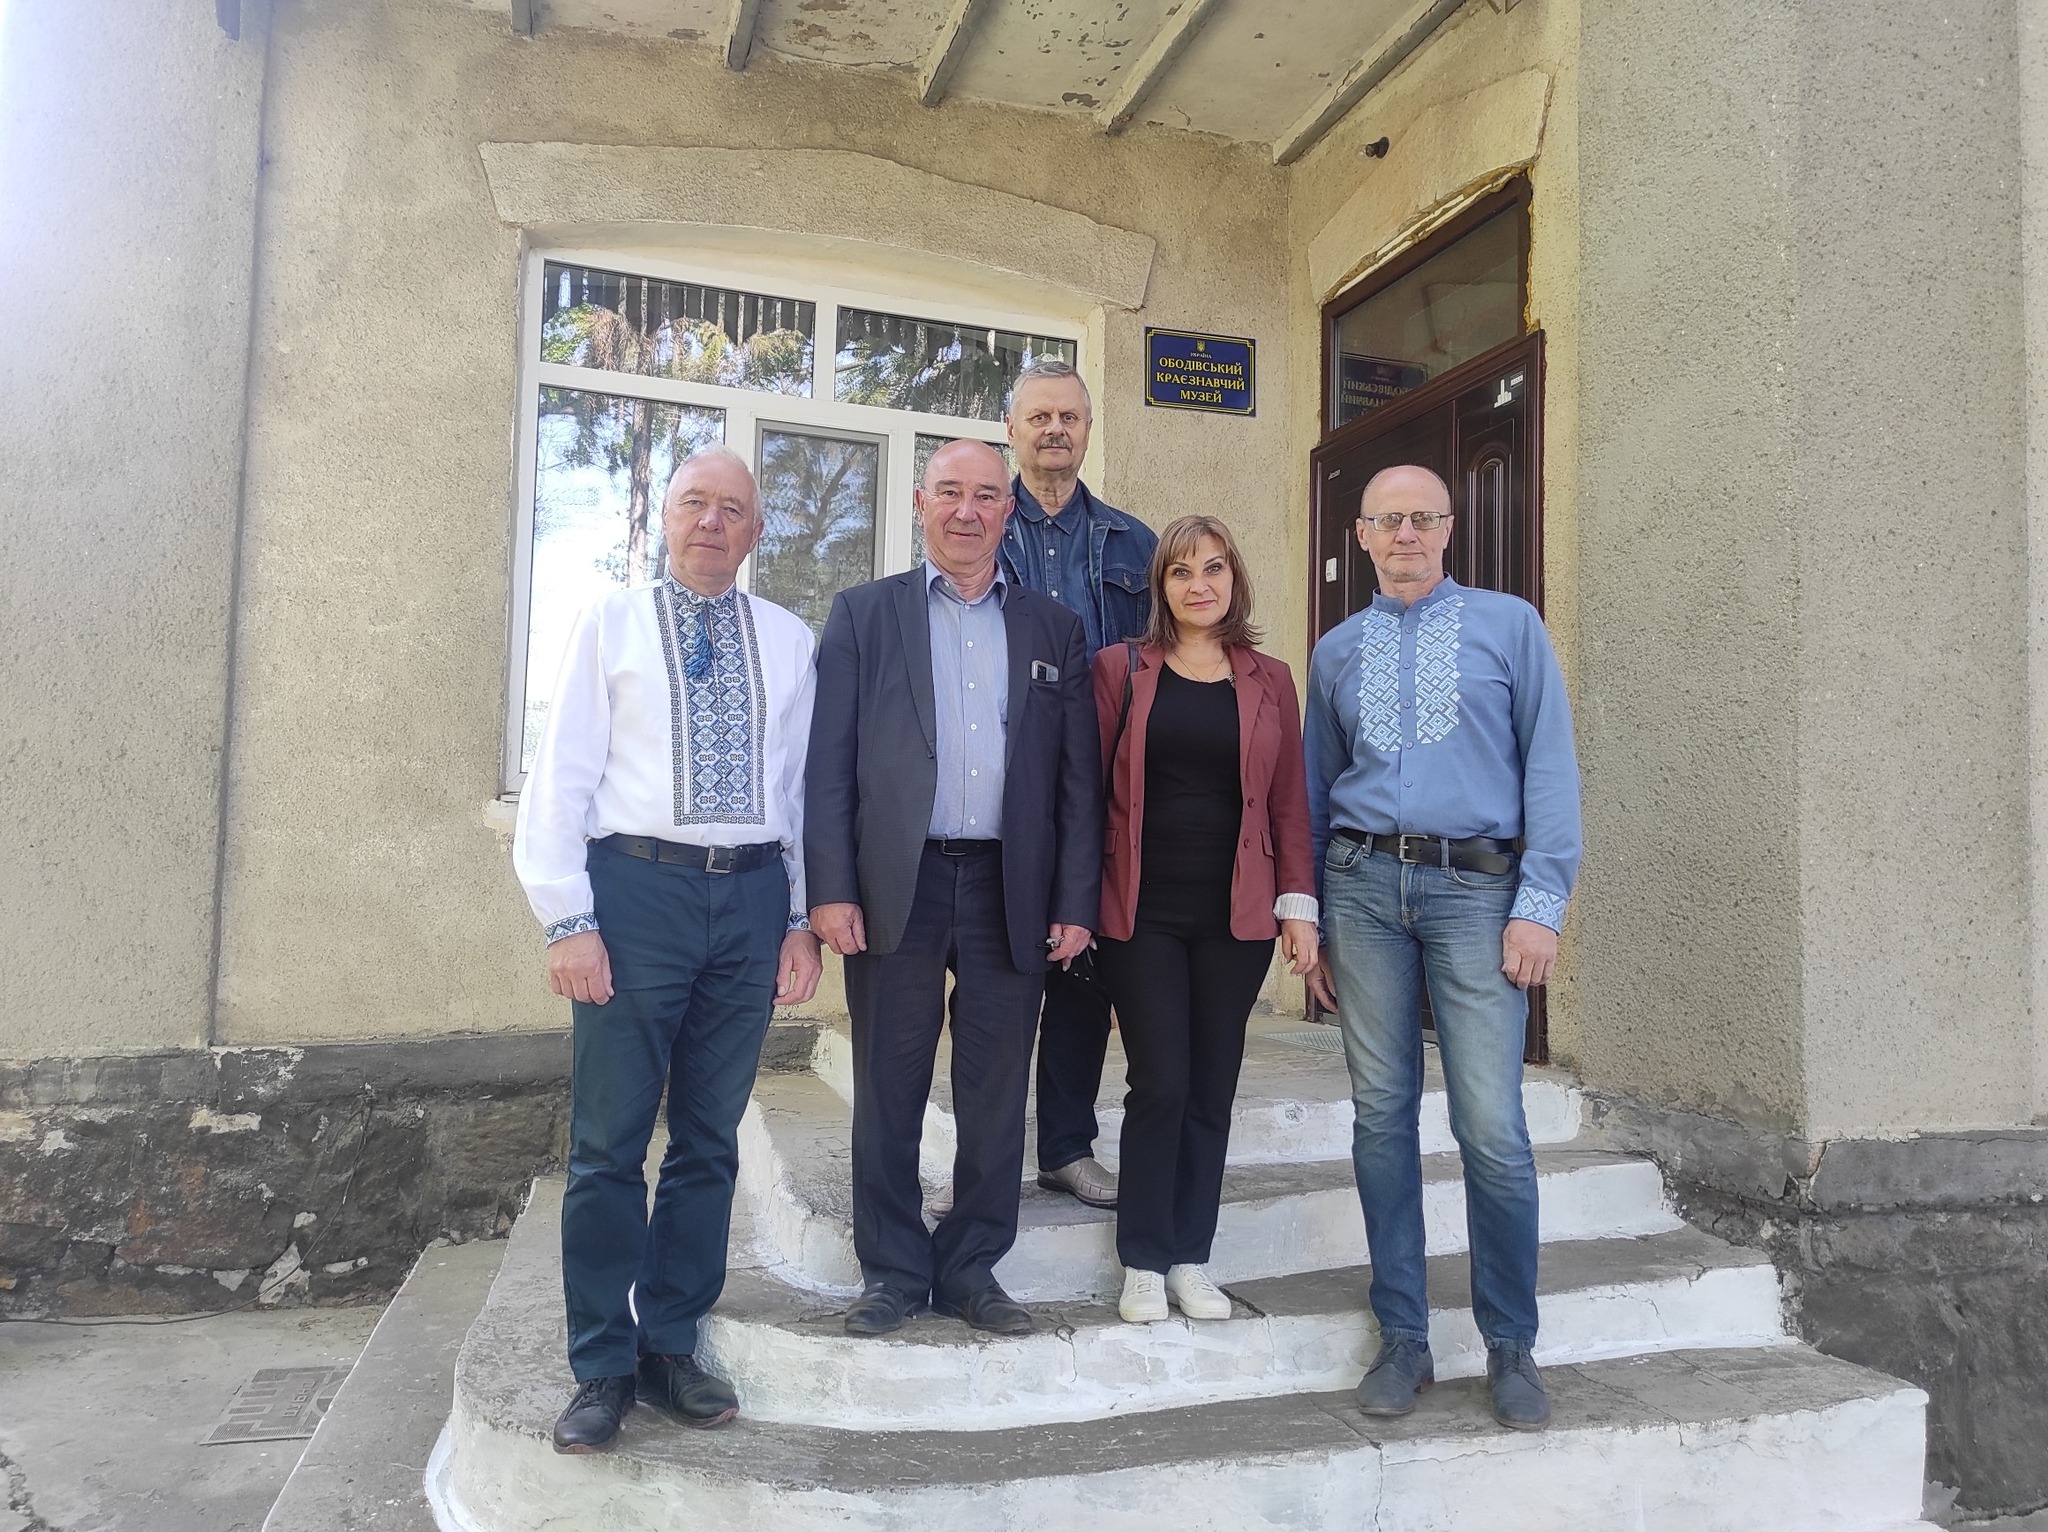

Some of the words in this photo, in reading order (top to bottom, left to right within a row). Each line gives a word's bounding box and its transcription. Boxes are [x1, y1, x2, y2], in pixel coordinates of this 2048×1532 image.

[1159, 357, 1243, 375] ОБОДІВСЬКИЙ
[1156, 371, 1246, 391] КРАЄЗНАВЧИЙ
[1180, 389, 1222, 403] МУЗЕЙ
